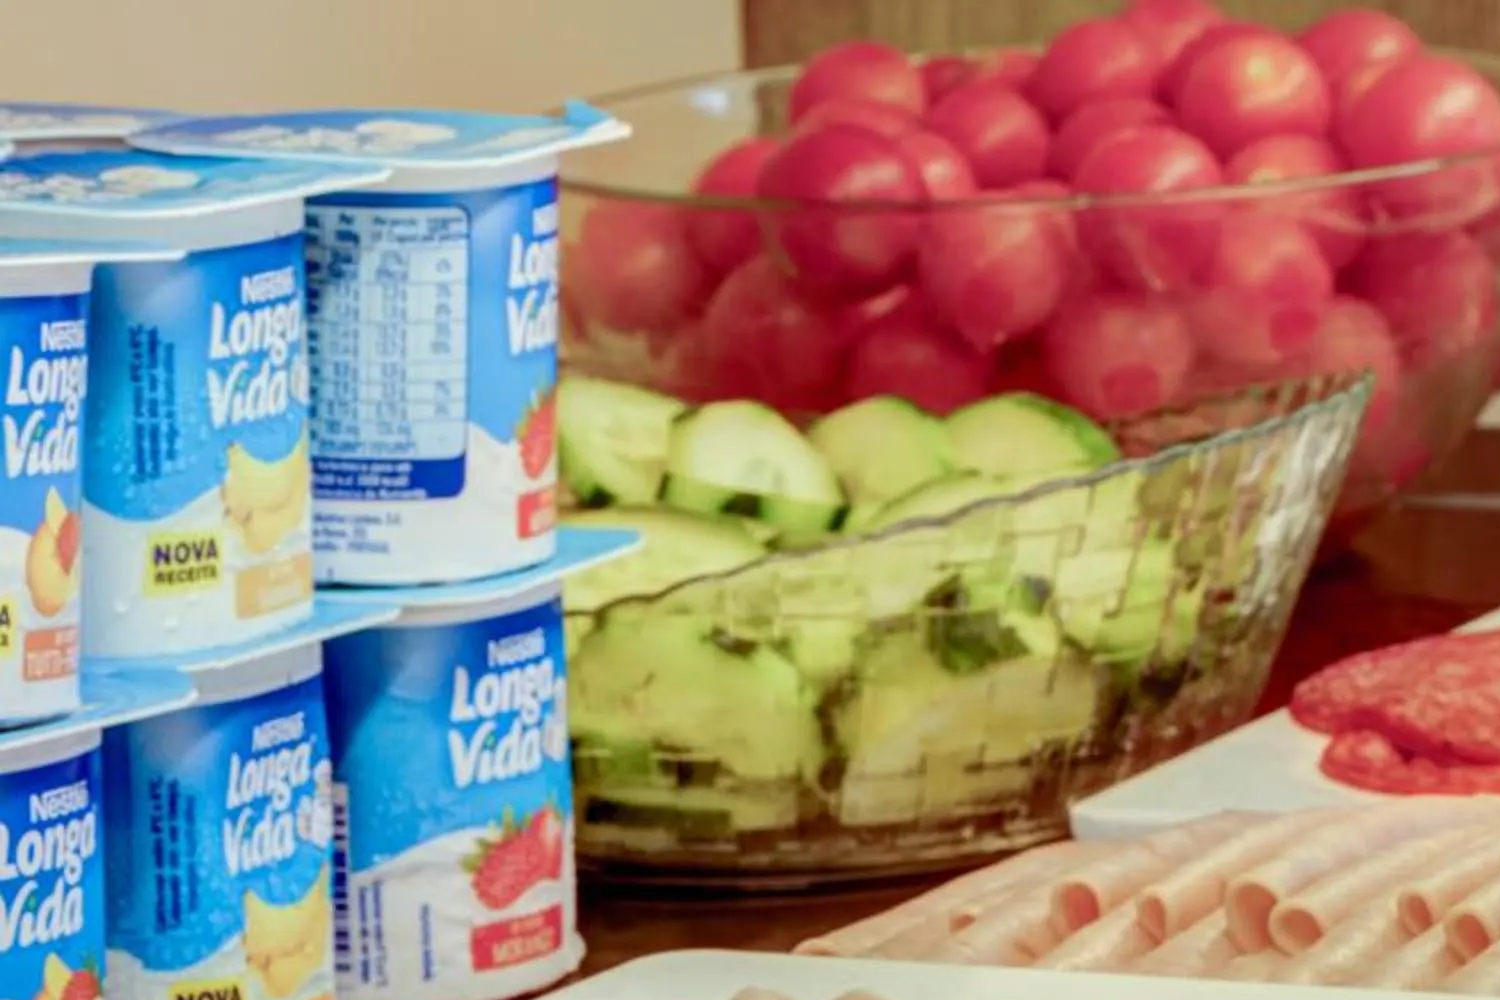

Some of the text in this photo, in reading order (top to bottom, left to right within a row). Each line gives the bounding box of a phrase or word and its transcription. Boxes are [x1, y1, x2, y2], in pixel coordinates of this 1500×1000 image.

[209, 300, 300, 368] Longa
[206, 360, 288, 430] Vida
[3, 409, 79, 479] Vida
[154, 538, 218, 566] NOVA
[155, 564, 218, 586] RECEITA
[450, 657, 554, 726] Longa
[226, 741, 313, 812] Longa
[448, 719, 543, 788] Vida
[223, 805, 294, 877] Vida
[0, 877, 83, 953] Vida
